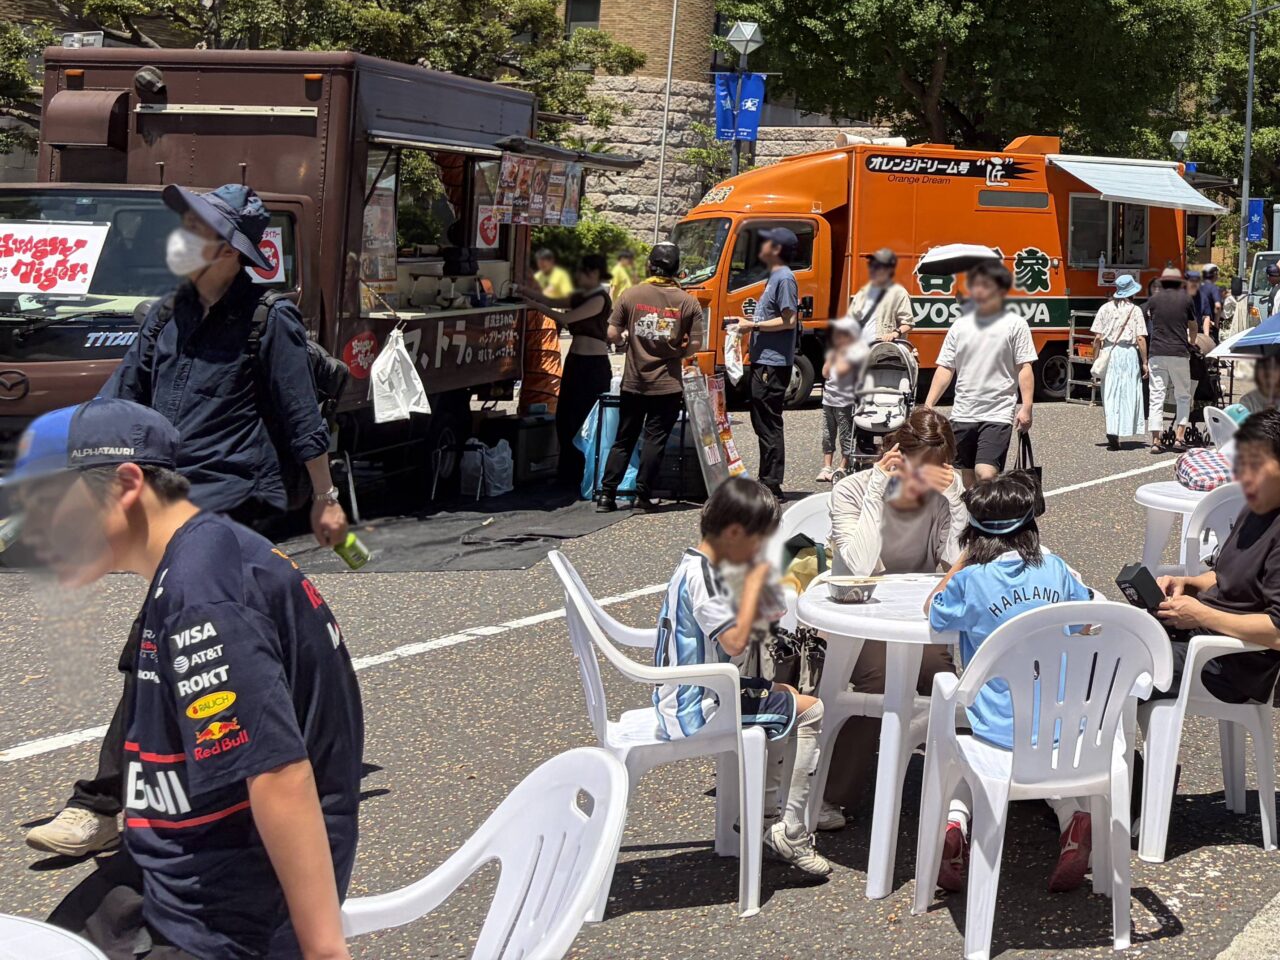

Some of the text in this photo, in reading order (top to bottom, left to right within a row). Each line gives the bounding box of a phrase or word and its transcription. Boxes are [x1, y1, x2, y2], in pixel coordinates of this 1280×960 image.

[868, 157, 970, 175] オレンジドリーム号
[887, 174, 951, 185] Orange Dream
[912, 302, 1051, 324] YOSOYA
[71, 447, 135, 458] ALPHATAURI
[988, 585, 1060, 618] HAALAND
[169, 621, 218, 649] VISA
[190, 644, 224, 667] AT&T
[177, 664, 230, 697] ROKT
[198, 694, 229, 712] RAUCH
[194, 729, 250, 761] Red Bull
[126, 761, 192, 815] Bull
